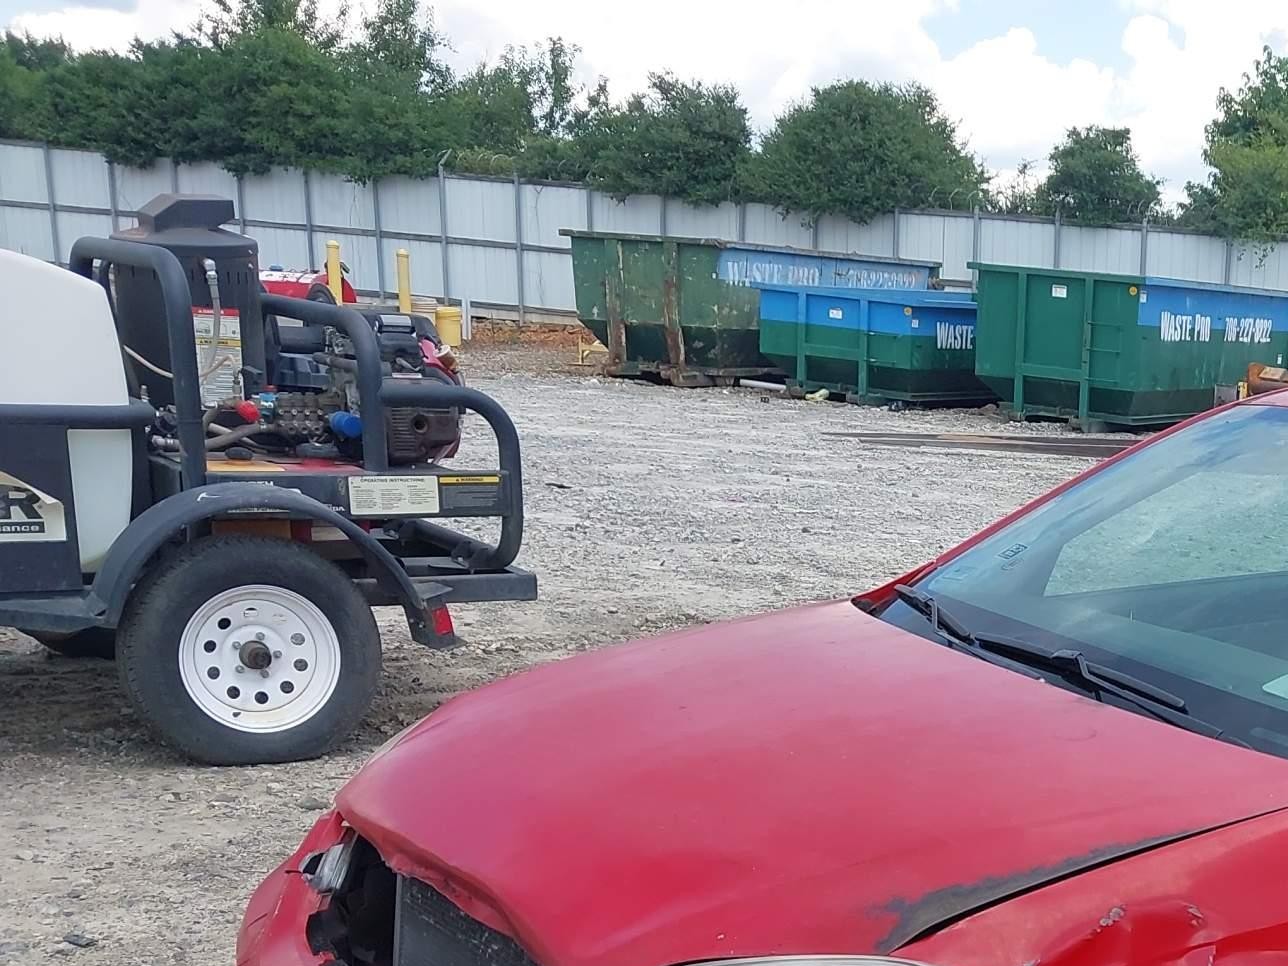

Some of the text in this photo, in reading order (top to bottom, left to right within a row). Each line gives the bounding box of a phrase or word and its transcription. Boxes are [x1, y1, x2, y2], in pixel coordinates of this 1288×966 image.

[726, 261, 820, 286] WASTE PRO
[936, 321, 974, 350] WASTE
[1160, 311, 1192, 342] WASTE
[1194, 313, 1211, 342] PRO
